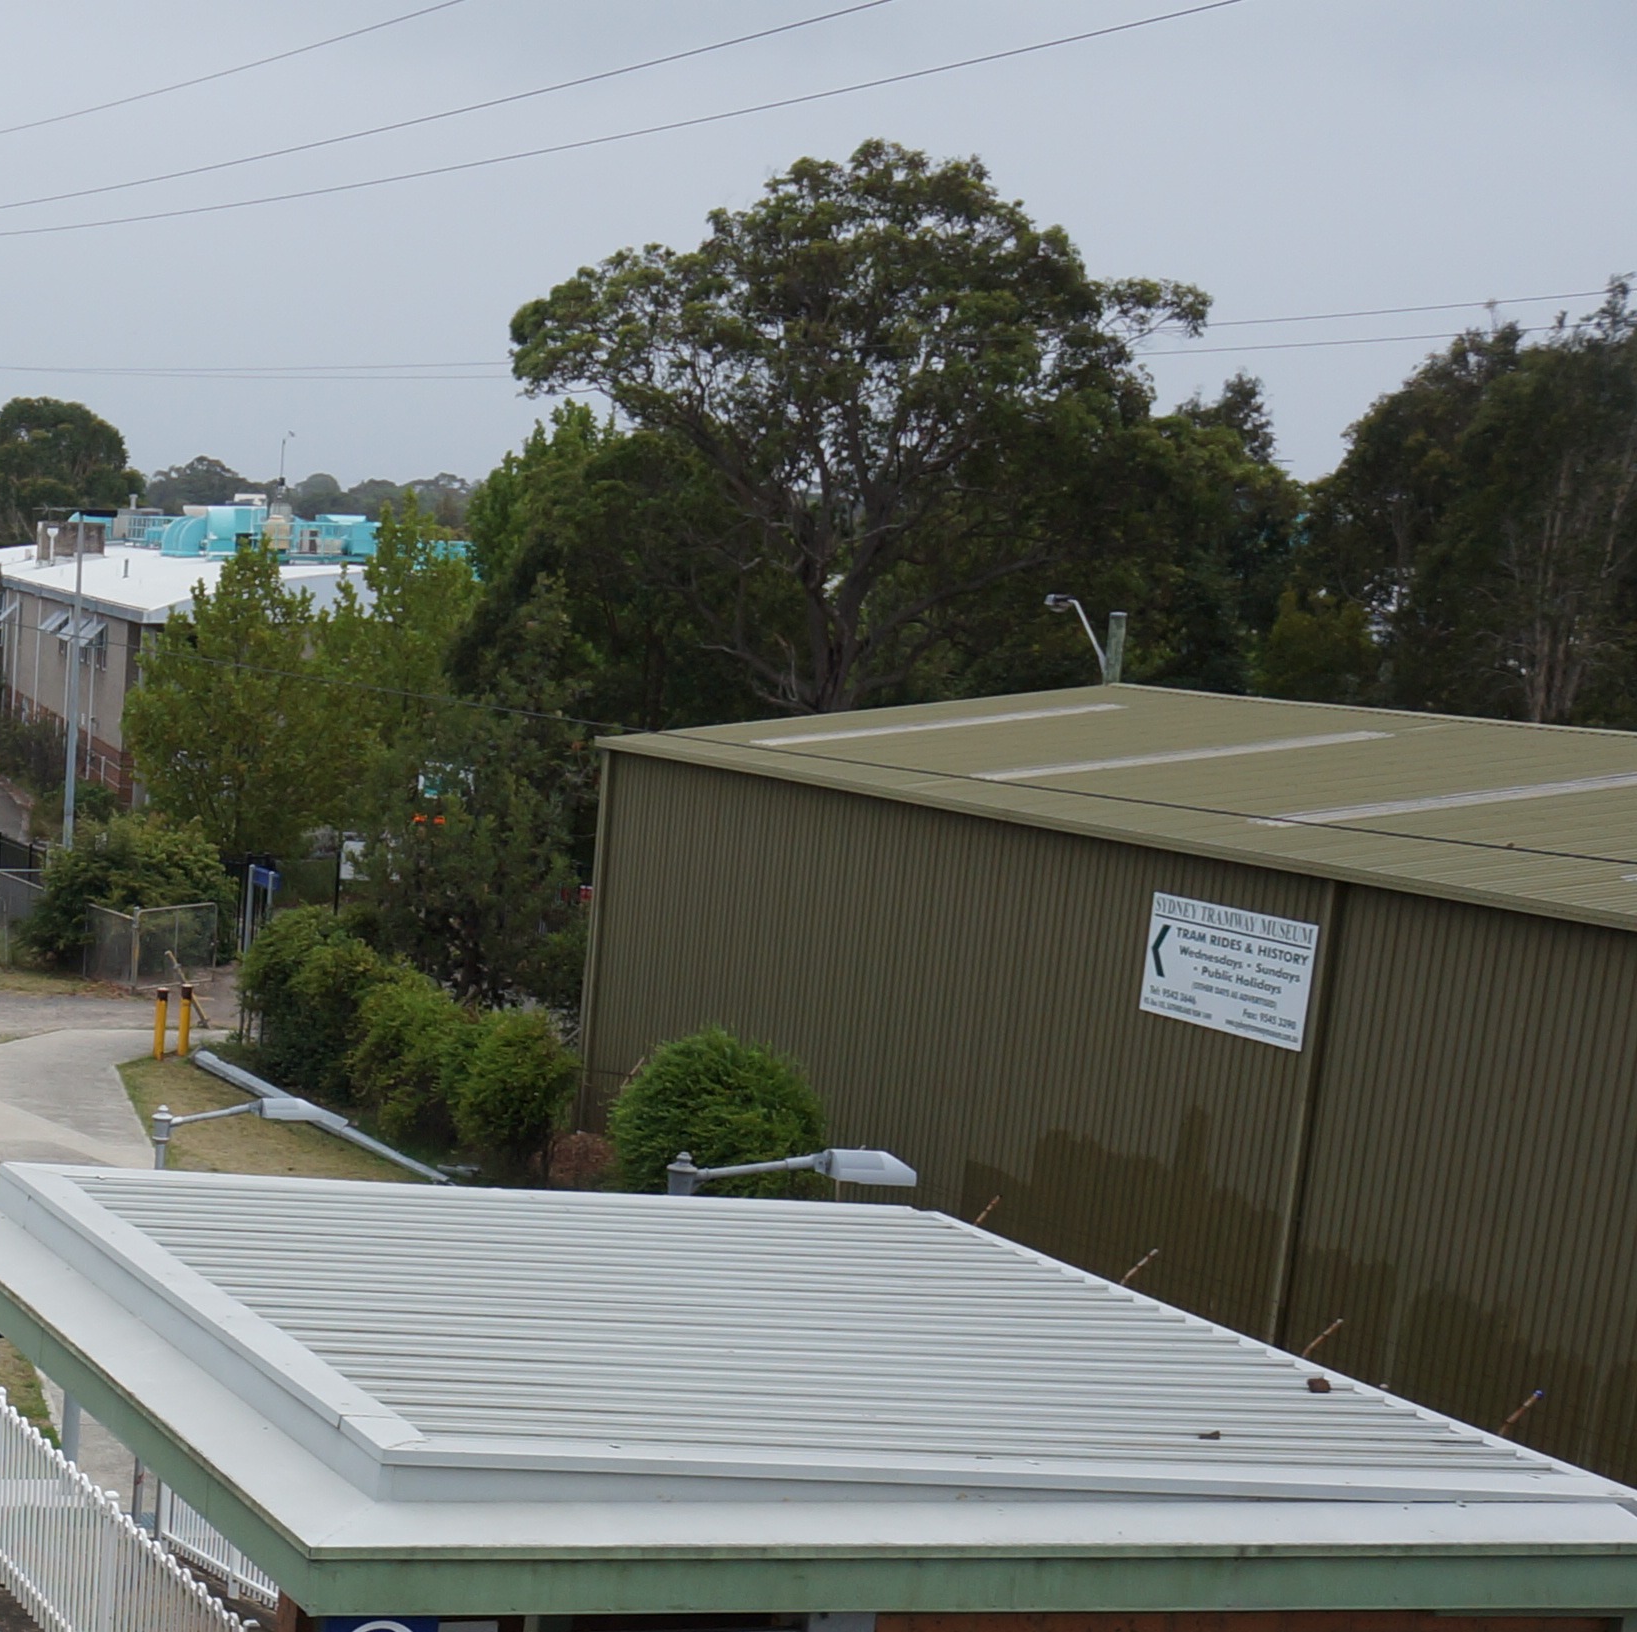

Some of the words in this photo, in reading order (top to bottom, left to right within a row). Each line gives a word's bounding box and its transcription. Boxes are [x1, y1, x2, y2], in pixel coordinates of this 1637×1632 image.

[1155, 896, 1197, 919] SYDNEY
[1201, 906, 1259, 932] TRAMWAY
[1260, 919, 1314, 945] MUSEUM
[1176, 927, 1206, 944] TRAM
[1209, 934, 1242, 951] RIDES
[1244, 943, 1254, 954] &
[1258, 945, 1310, 966] HISTORY
[1179, 945, 1243, 970] Wednesdays
[1255, 963, 1301, 984] Sundays
[1201, 966, 1233, 983] Public
[1235, 974, 1282, 995] Holidays
